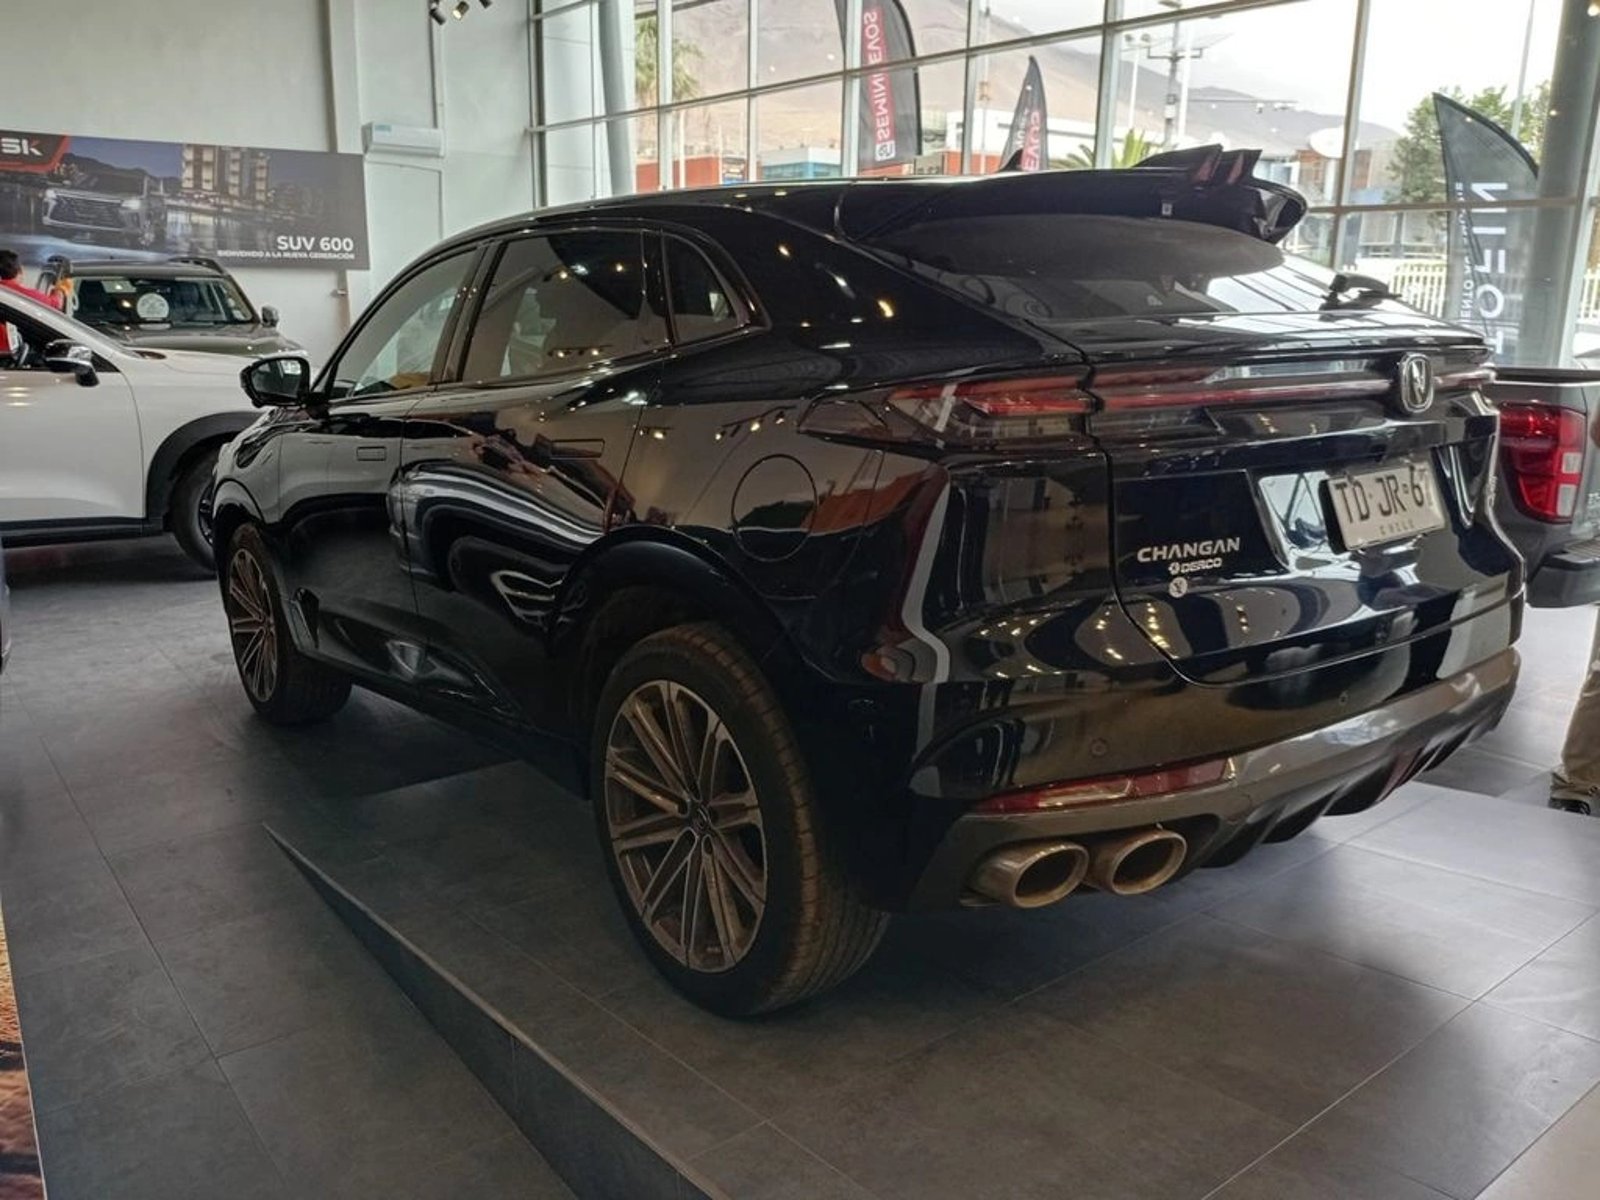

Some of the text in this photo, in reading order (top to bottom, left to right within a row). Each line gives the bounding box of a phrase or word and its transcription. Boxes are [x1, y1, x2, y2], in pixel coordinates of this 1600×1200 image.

[277, 235, 354, 252] SUV 600
[1137, 536, 1241, 563] CHANGAN
